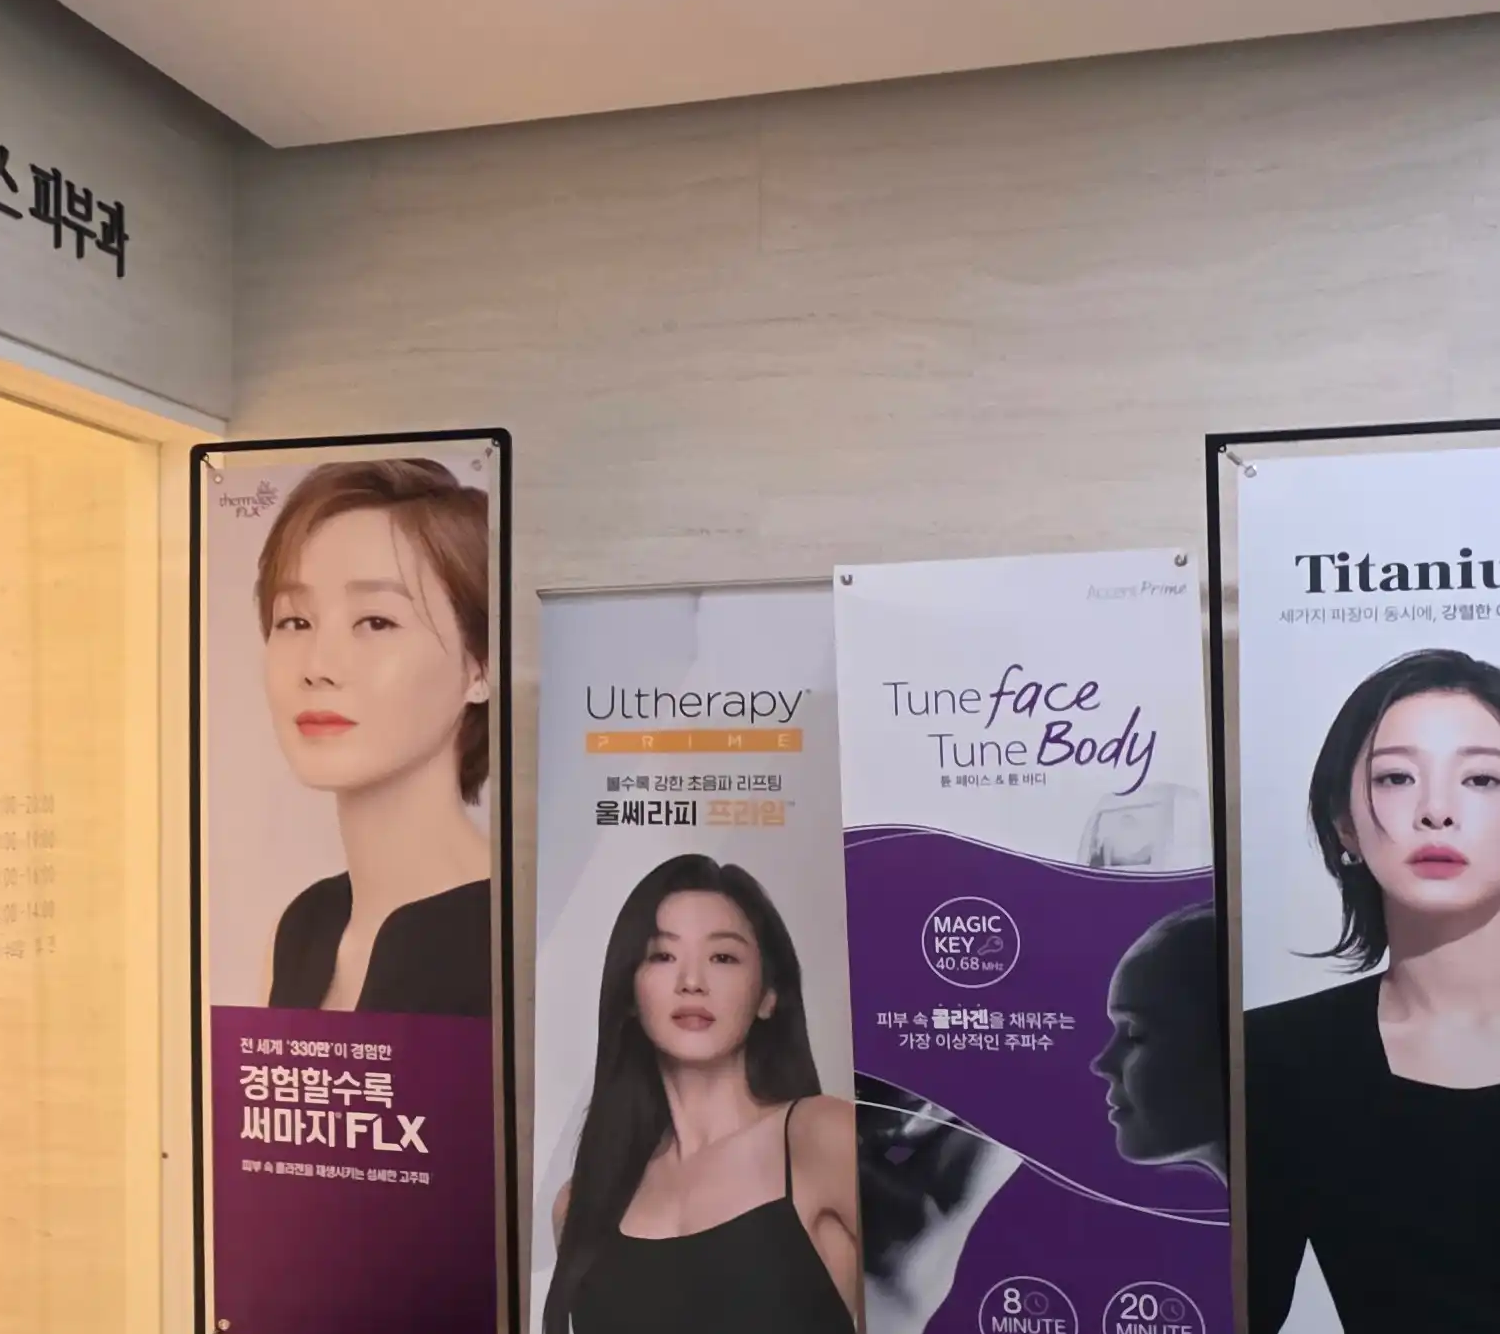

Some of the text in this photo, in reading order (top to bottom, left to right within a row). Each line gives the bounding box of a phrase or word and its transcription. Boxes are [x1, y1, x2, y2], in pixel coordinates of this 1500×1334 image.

[1279, 607, 1325, 624] 세가지
[1331, 606, 1378, 623] 파장이
[586, 685, 803, 724] Ultherapy
[883, 664, 1100, 729] Tune face
[597, 732, 791, 749] PRIME
[927, 706, 1157, 797] Tune Body
[654, 774, 684, 792] 강한
[687, 774, 732, 792] 초음파
[736, 774, 782, 792] 리프팅
[1022, 771, 1047, 786] 바디
[595, 799, 785, 827] 울쎄라피 프라임
[933, 915, 1002, 934] MAGIC
[934, 936, 975, 954] KEY
[935, 956, 980, 972] 40.68
[876, 1008, 1076, 1030] 피부 속 콜라겐을 채워주는
[240, 1037, 253, 1054] 전
[257, 1038, 283, 1055] 세계
[350, 1043, 392, 1061] 경험한
[899, 1032, 1054, 1051] 가장 이상적인 주파수
[239, 1065, 394, 1109] 경험할수록
[346, 1111, 429, 1154] FLX
[1003, 1287, 1022, 1314] 8
[1120, 1293, 1159, 1321] 20
